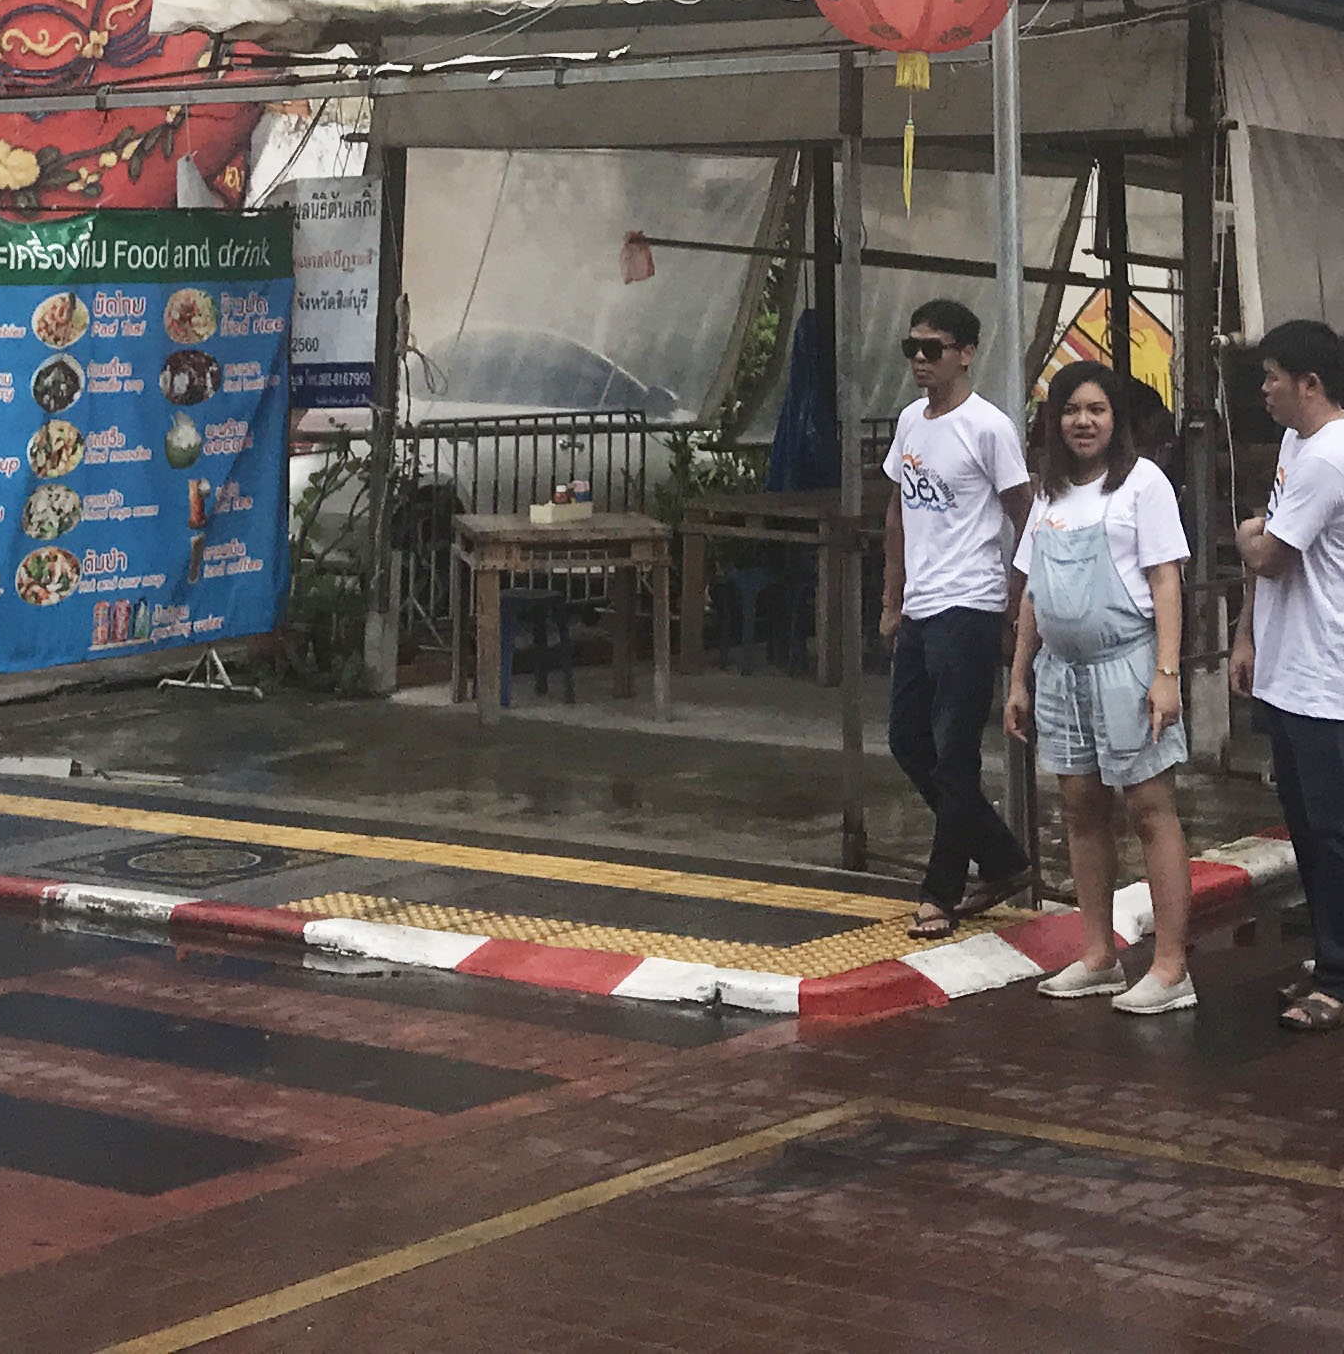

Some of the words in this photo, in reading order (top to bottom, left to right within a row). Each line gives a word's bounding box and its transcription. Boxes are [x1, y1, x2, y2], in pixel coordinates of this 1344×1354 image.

[114, 237, 170, 270] Food
[173, 236, 211, 269] and
[218, 236, 271, 268] drink
[902, 462, 940, 503] Sea
[82, 547, 128, 575] ต้มยำ
